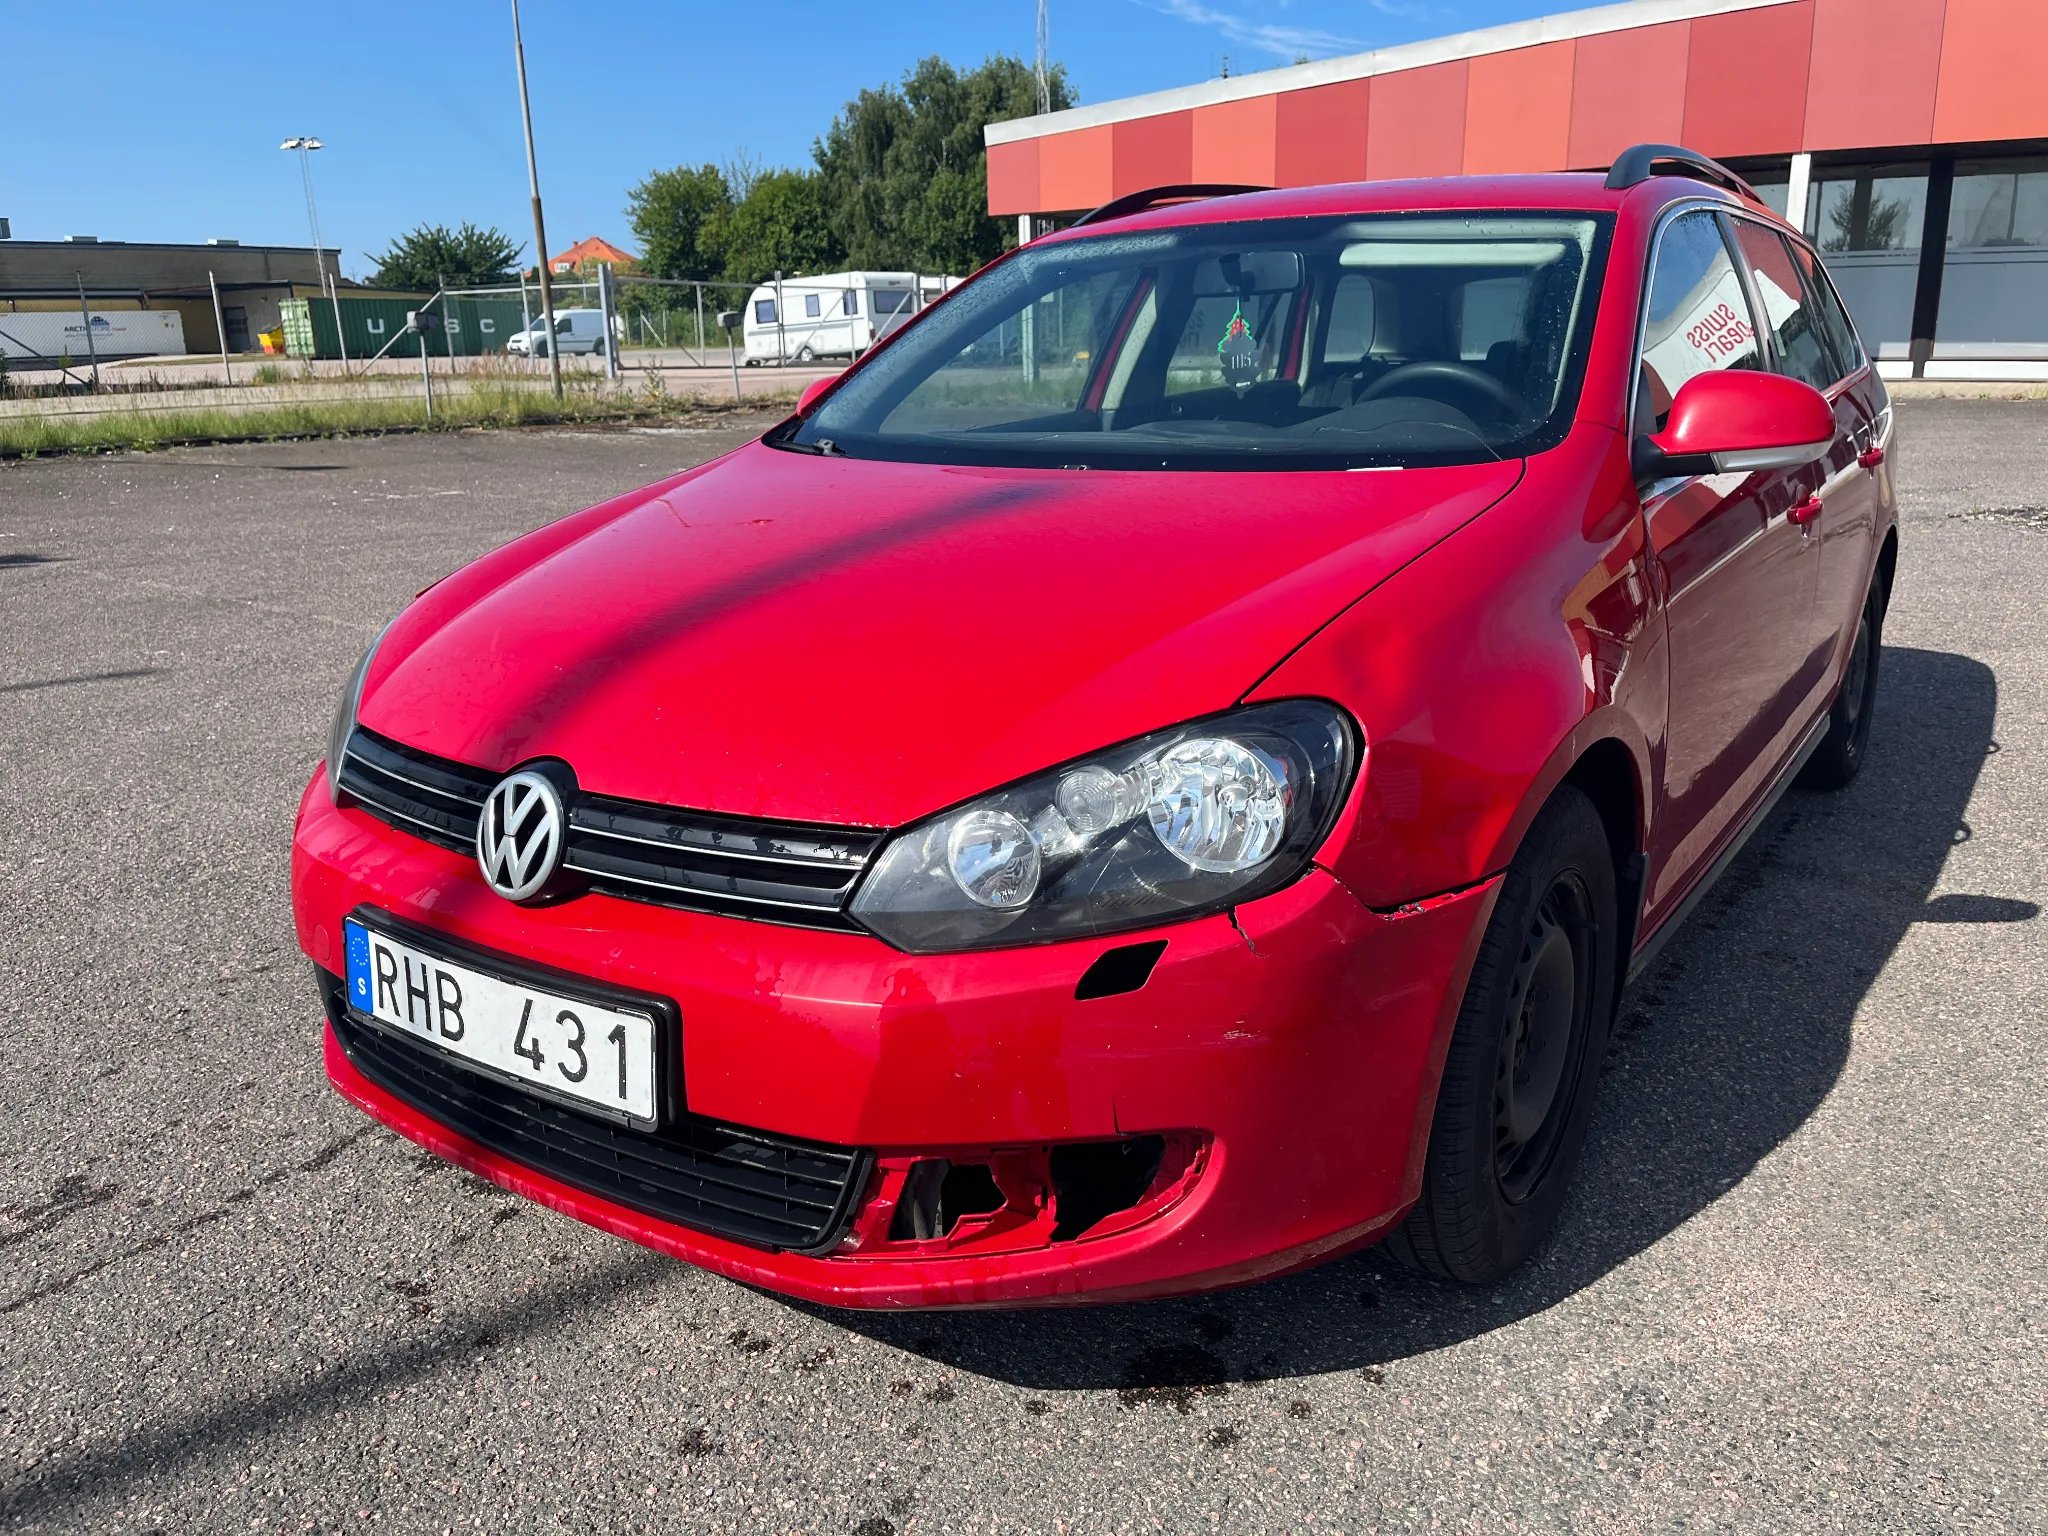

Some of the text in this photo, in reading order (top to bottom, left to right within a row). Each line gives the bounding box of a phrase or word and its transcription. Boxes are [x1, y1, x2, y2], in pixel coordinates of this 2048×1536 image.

[357, 976, 368, 997] S
[374, 942, 629, 1101] RHB 431
